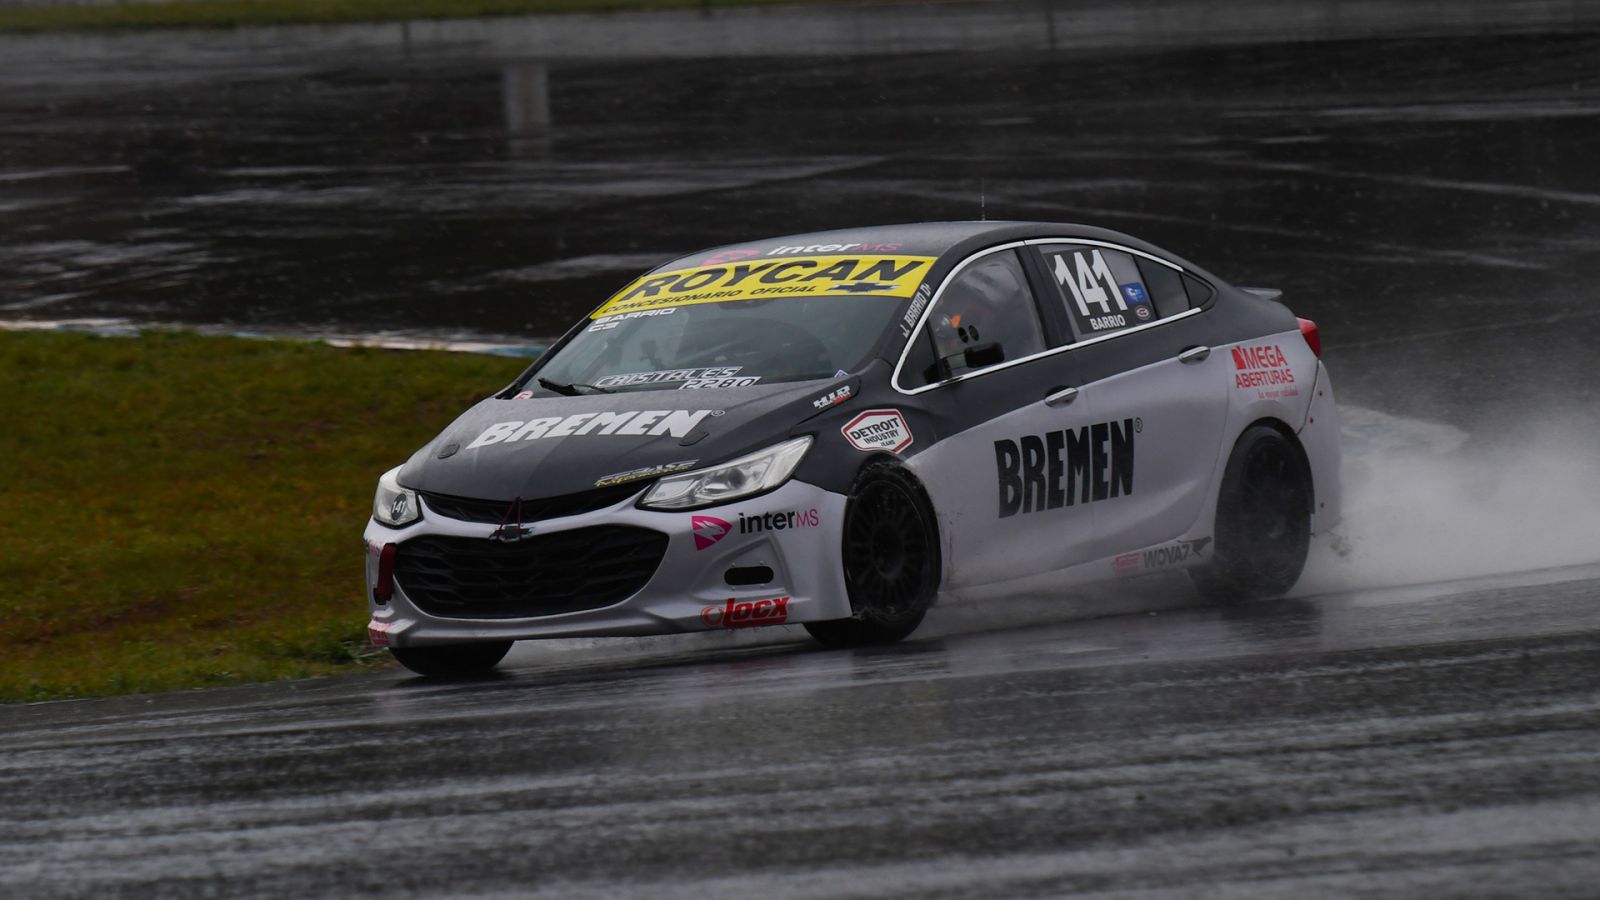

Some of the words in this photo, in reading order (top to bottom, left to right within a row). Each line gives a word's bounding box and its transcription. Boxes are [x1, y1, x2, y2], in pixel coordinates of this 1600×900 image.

[618, 259, 926, 302] ROYCAN
[1053, 249, 1128, 316] 141
[603, 289, 744, 313] CONCESIONARIO
[750, 285, 817, 296] OFICIAL
[903, 291, 927, 328] BARRIO
[595, 307, 677, 324] BARRIO
[1089, 314, 1126, 331] BARRIO
[1243, 345, 1289, 369] MEGA
[596, 366, 741, 387] CRISTALES
[1235, 369, 1295, 389] ABERTURAS
[465, 409, 712, 450] BREMEN
[849, 417, 900, 440] DETROIT
[863, 429, 900, 445] INDUSTRY
[993, 418, 1136, 519] BREMEN
[391, 500, 407, 514] 141
[738, 508, 820, 535] interMS
